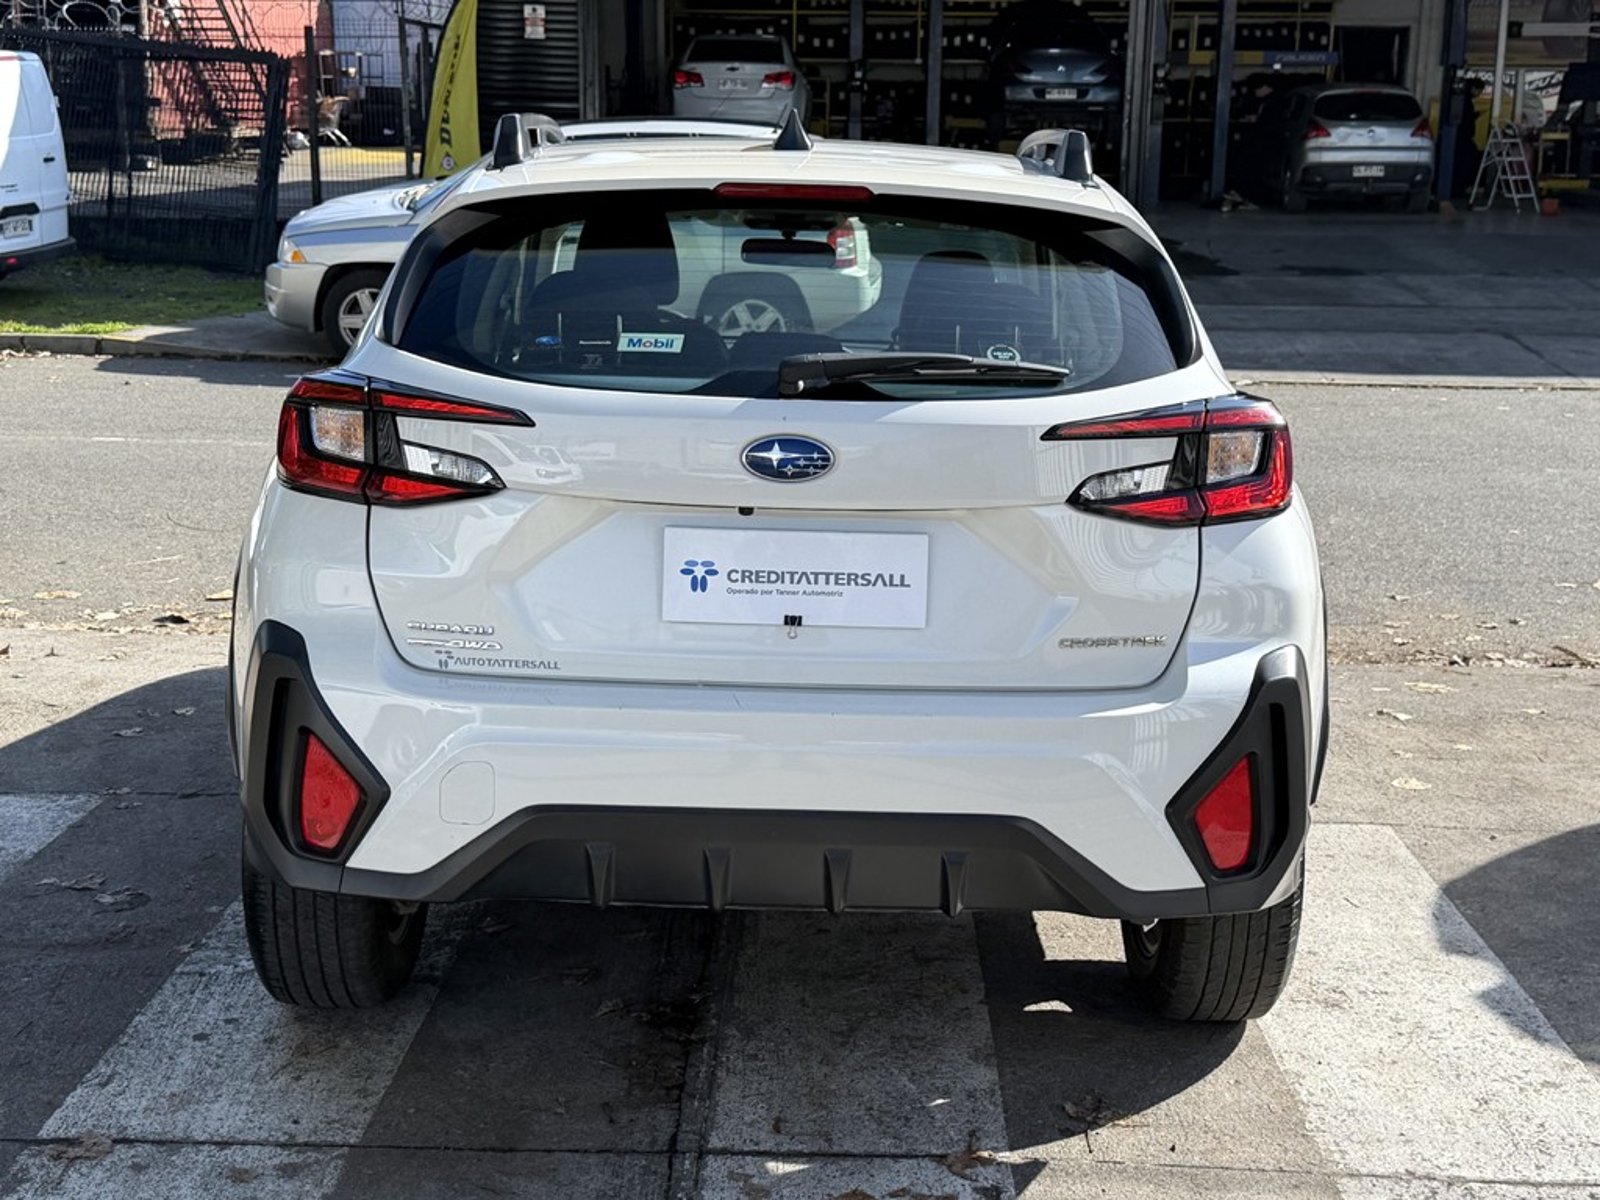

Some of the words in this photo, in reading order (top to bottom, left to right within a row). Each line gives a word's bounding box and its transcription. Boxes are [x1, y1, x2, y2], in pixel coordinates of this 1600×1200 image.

[627, 338, 675, 351] Mobil
[727, 569, 911, 587] CREDITATTERSALL
[726, 587, 759, 595] Operado
[760, 588, 773, 597] por
[775, 589, 800, 597] Tanner
[801, 590, 843, 598] Automotriz
[407, 621, 495, 635] SUBARU
[454, 656, 560, 669] AUTOTATTERSALL
